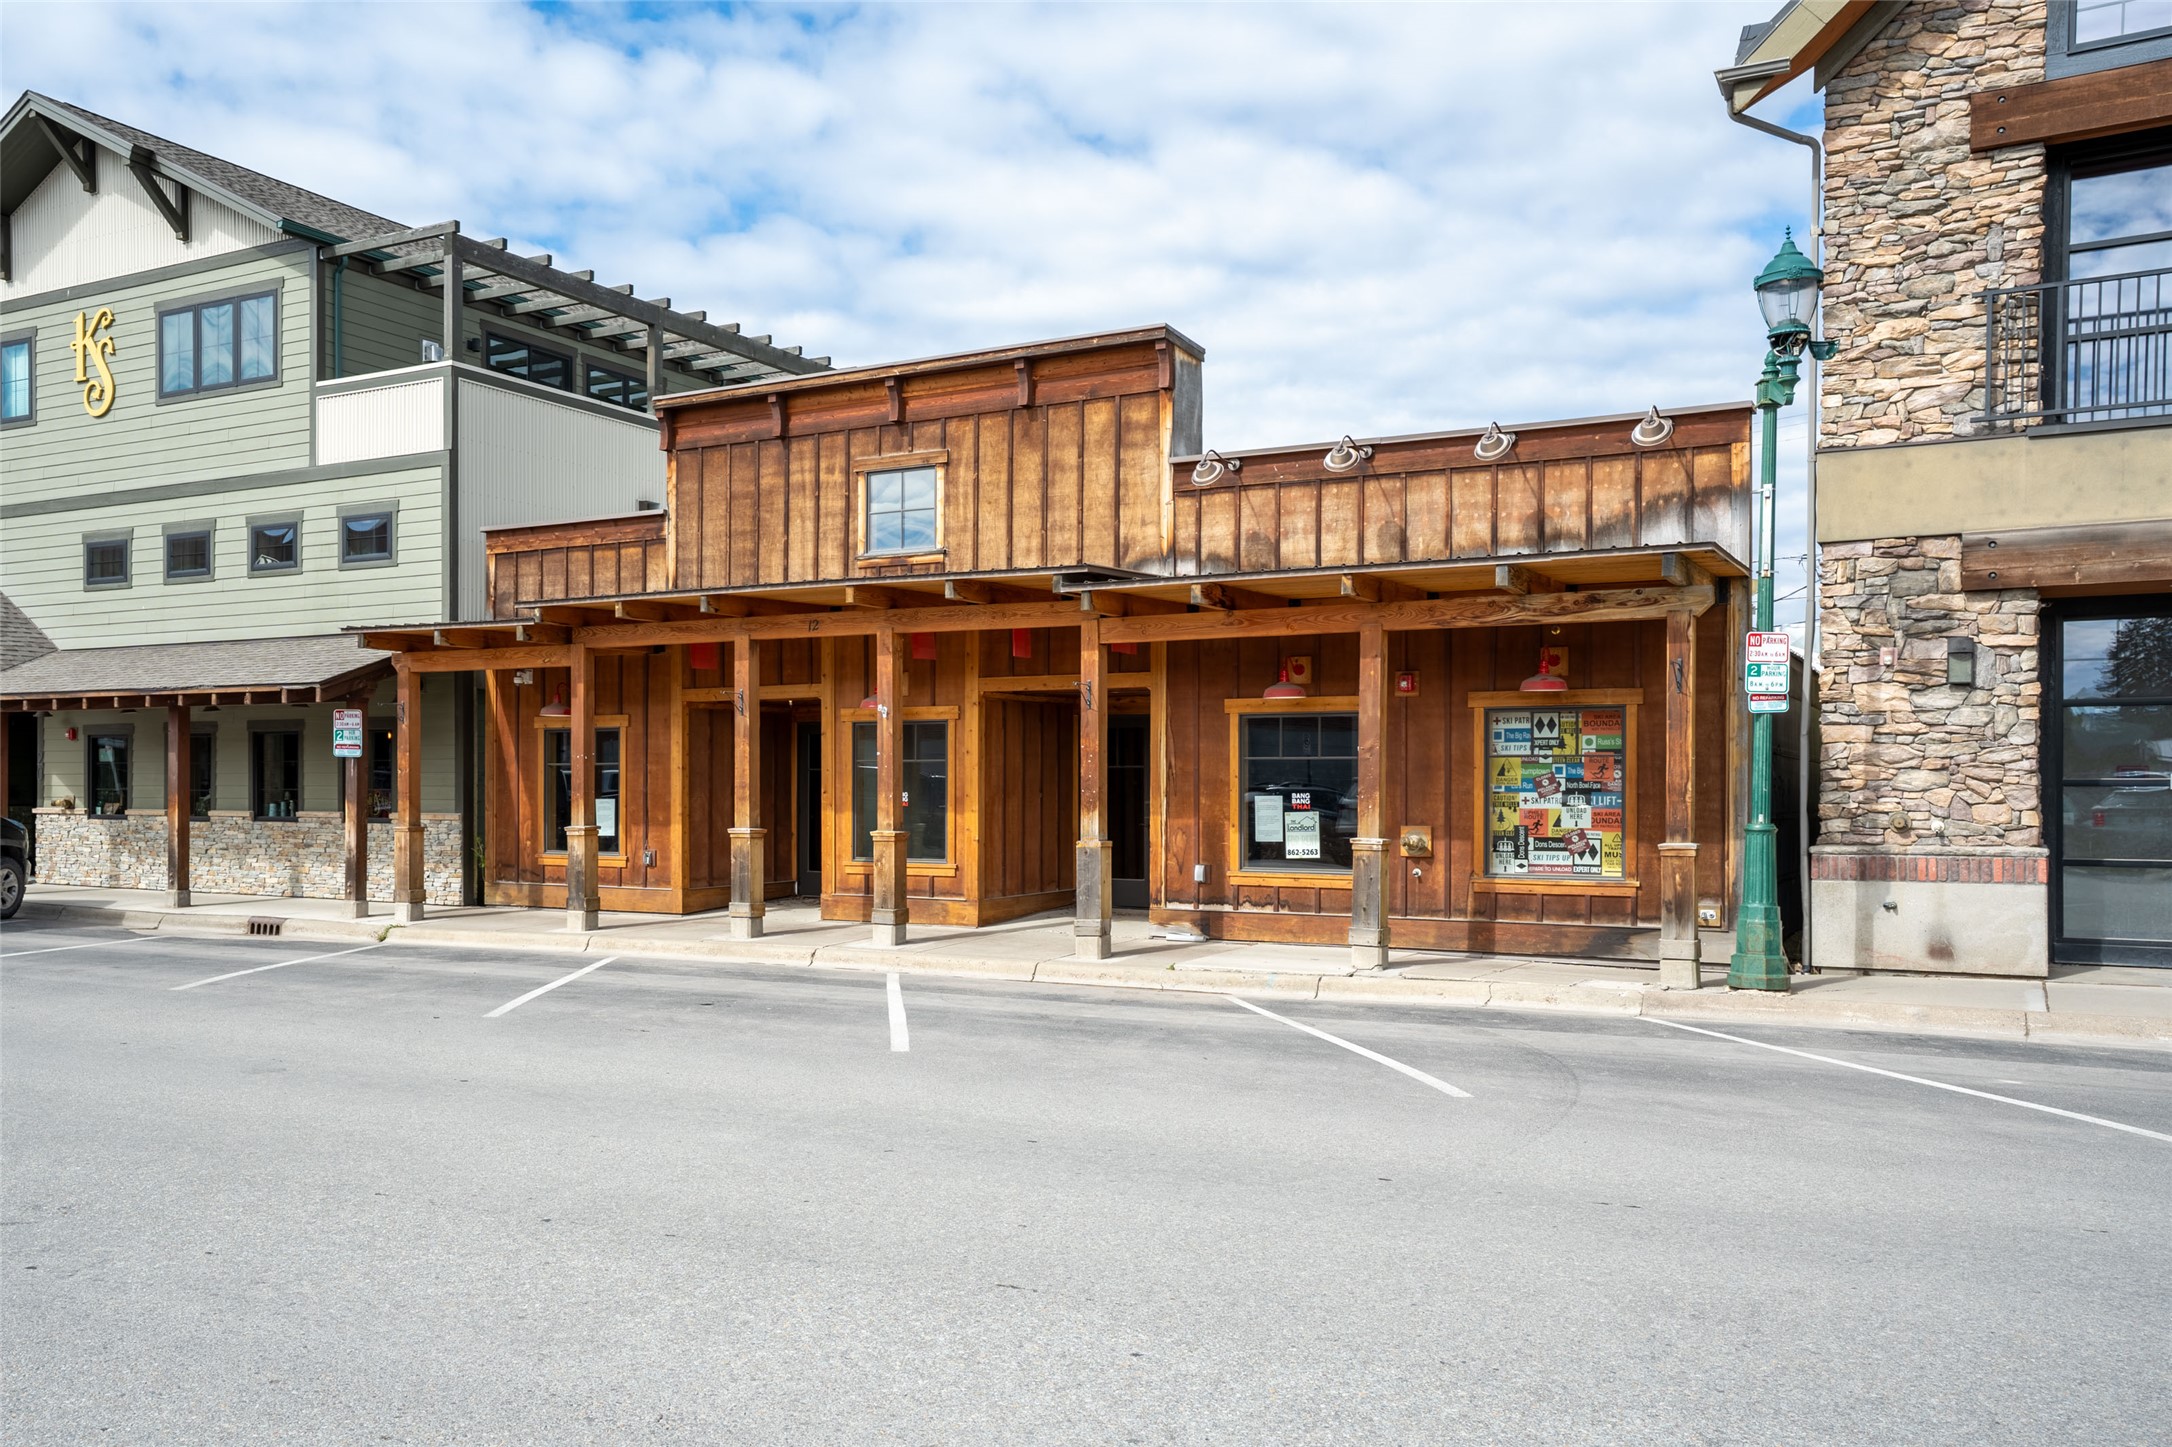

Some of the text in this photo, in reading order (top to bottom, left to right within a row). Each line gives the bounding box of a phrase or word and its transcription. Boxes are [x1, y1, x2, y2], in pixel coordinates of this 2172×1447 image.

[808, 619, 819, 632] 12
[1750, 635, 1787, 646] NO PARKING
[1750, 666, 1758, 676] 2
[336, 712, 344, 720] NO
[336, 730, 343, 740] 2
